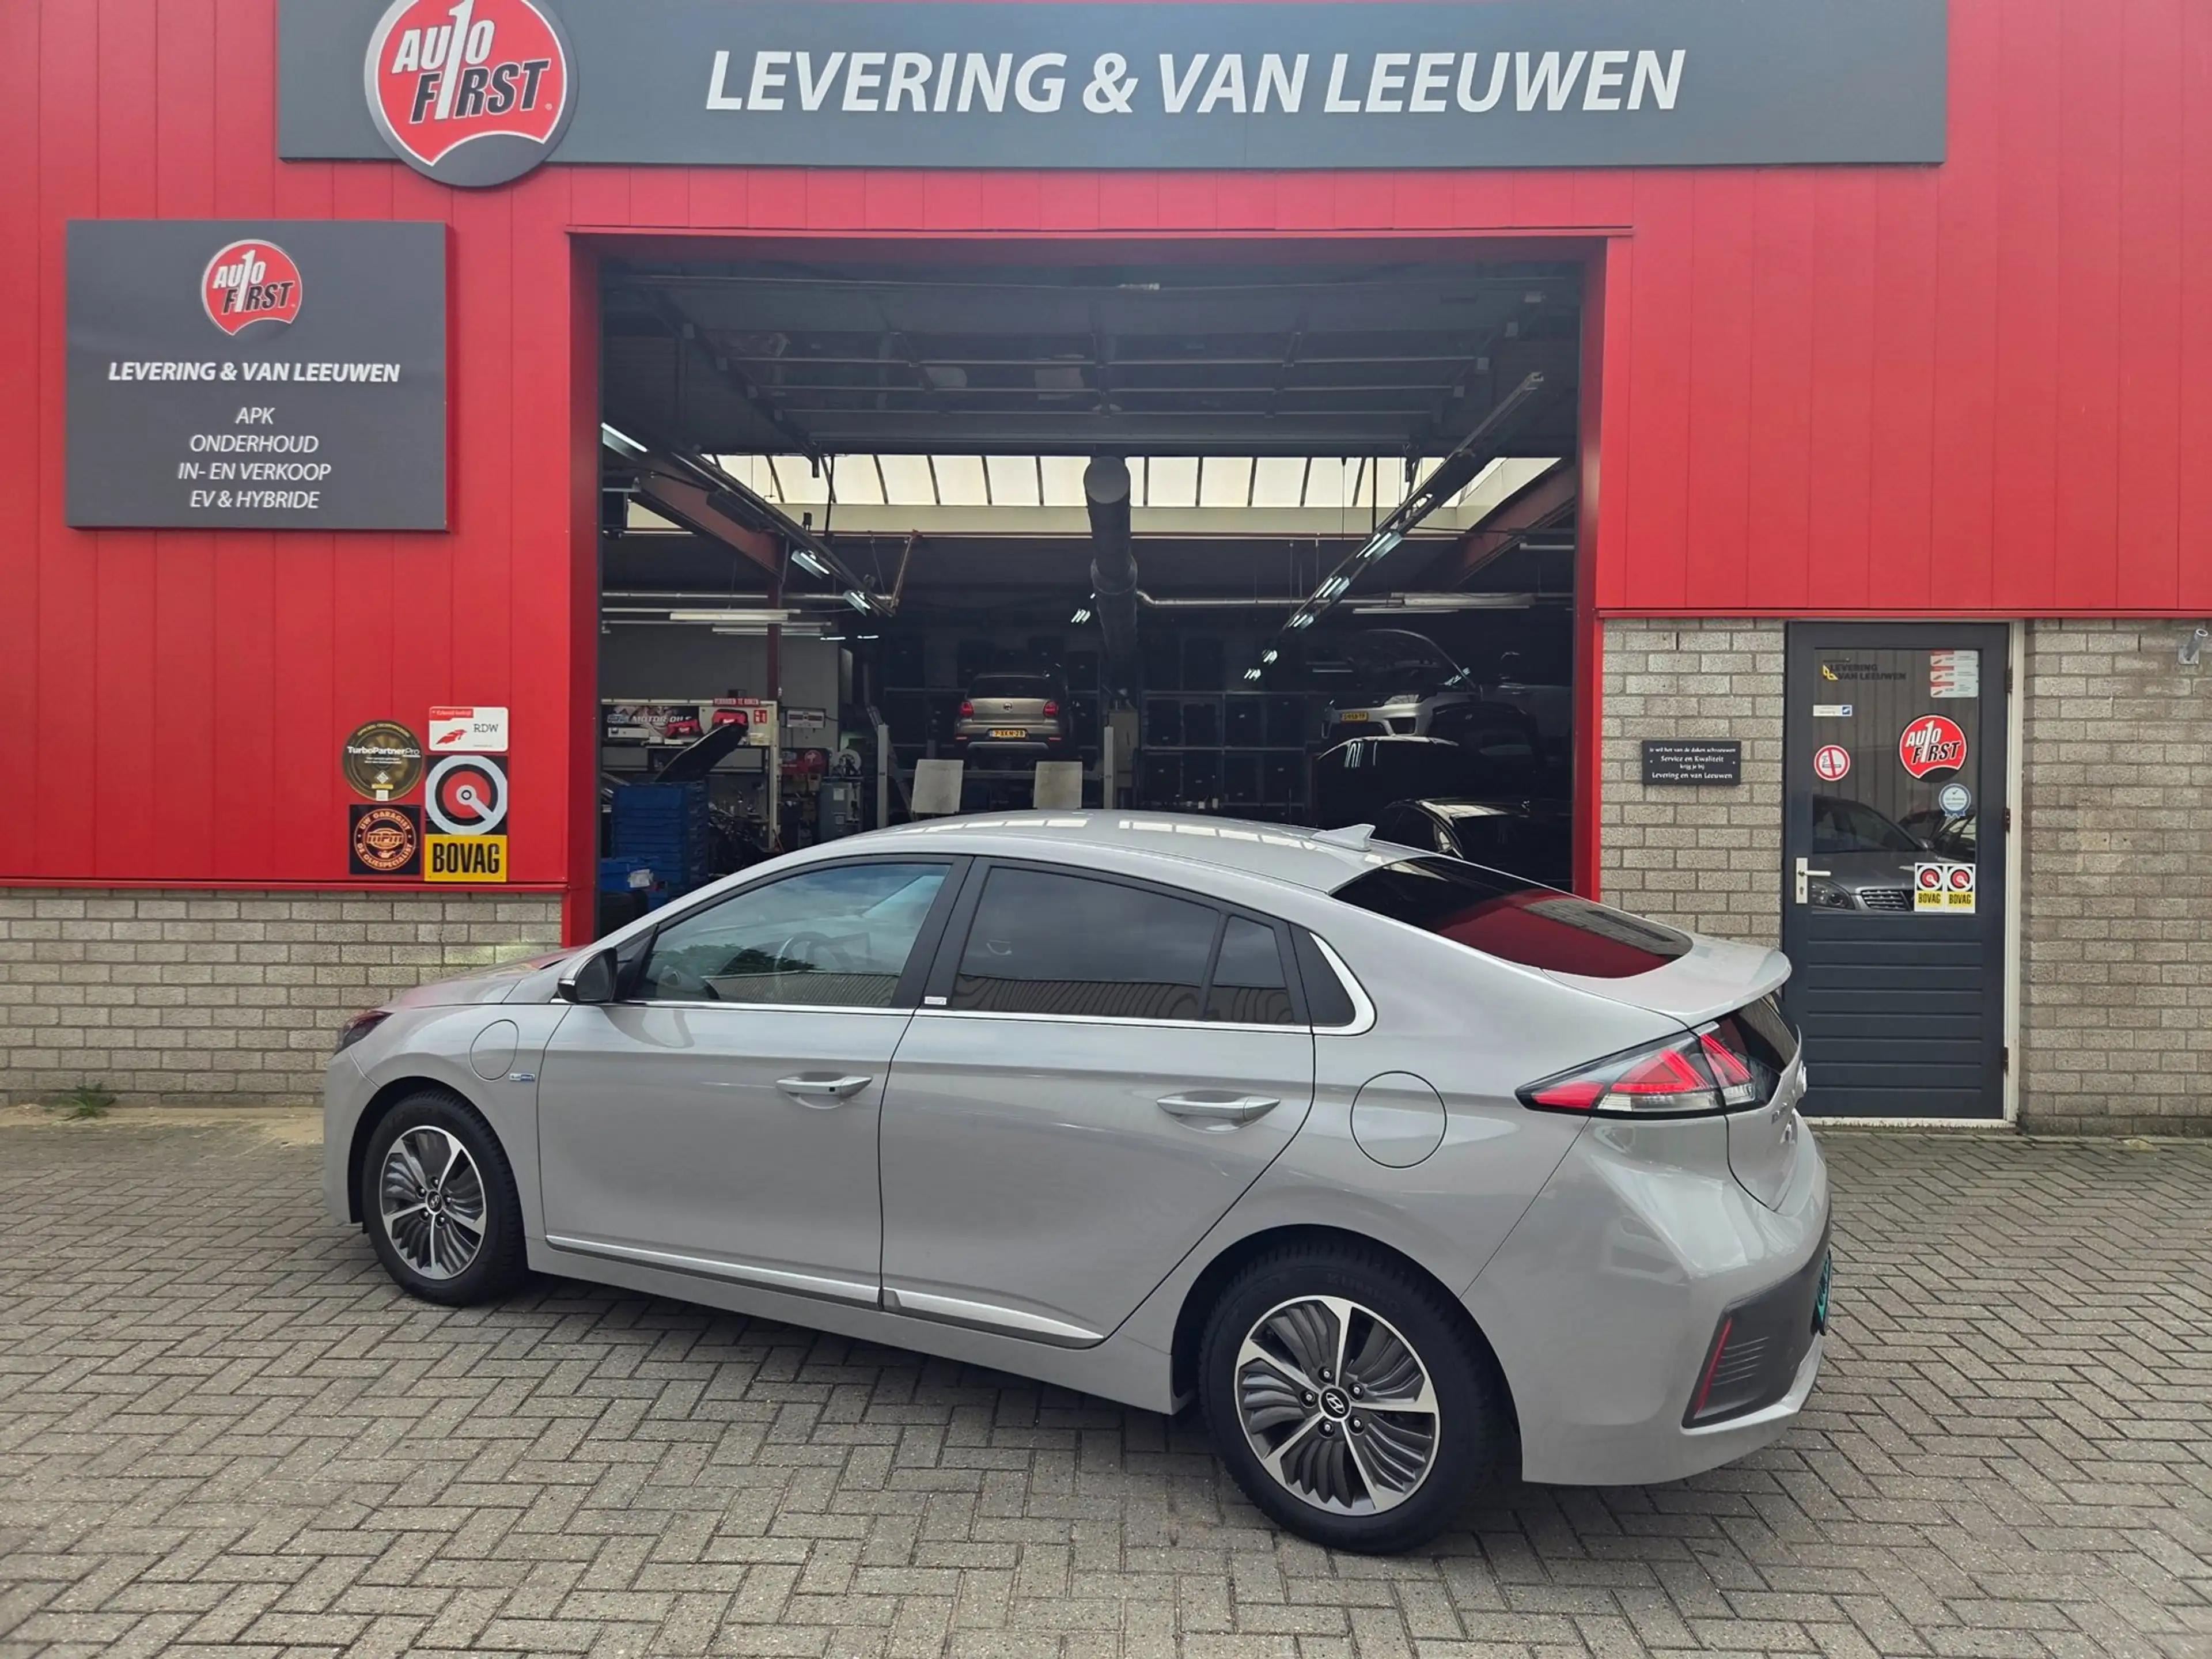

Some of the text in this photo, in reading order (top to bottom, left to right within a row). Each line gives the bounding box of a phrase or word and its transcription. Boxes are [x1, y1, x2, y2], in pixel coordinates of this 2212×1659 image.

[706, 49, 1686, 113] LEVERING & VAN LEEUWEN
[108, 362, 400, 382] LEVERING & VAN LEEUWEN
[235, 407, 275, 425] APK
[190, 434, 319, 453] ONDERHOUD
[177, 463, 331, 480] IN- EN VERKOOP
[190, 491, 320, 509] EV & HYBRIDE
[474, 723, 499, 733] RDW
[1652, 772, 1679, 781] Levering
[359, 817, 371, 830] UW
[432, 843, 501, 874] BOVAG
[1918, 893, 1941, 904] BOVAG
[1949, 893, 1972, 904] BOVAG
